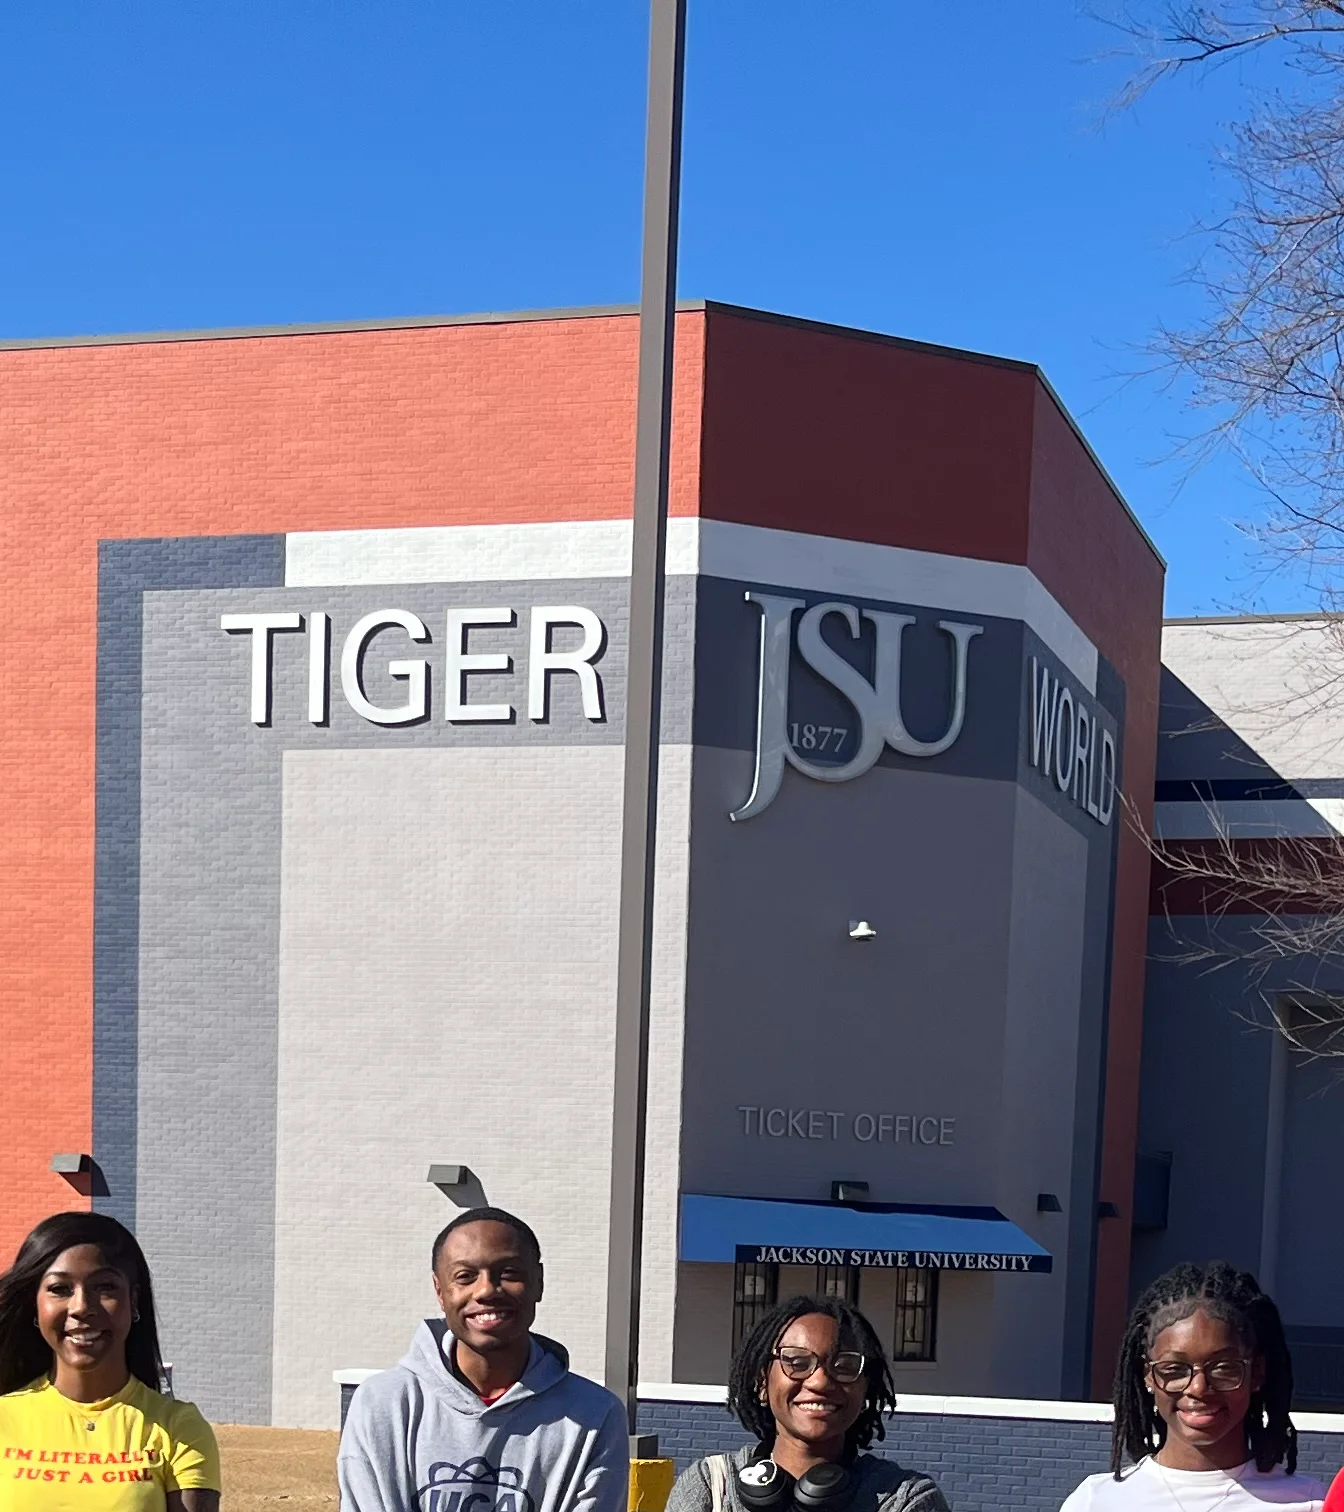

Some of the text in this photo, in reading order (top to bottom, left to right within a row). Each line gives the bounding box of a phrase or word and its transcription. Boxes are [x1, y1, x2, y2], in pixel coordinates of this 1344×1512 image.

[220, 605, 607, 727] TIGER
[729, 591, 984, 821] JSU
[789, 721, 848, 754] 1877
[1027, 655, 1116, 826] WORLD
[738, 1105, 956, 1146] TICKET OFFICE
[755, 1246, 1033, 1271] JACKSON STATE UNIVERSITY
[2, 1447, 156, 1465] I'M LITERALLY
[13, 1467, 154, 1484] JUST A GIRL
